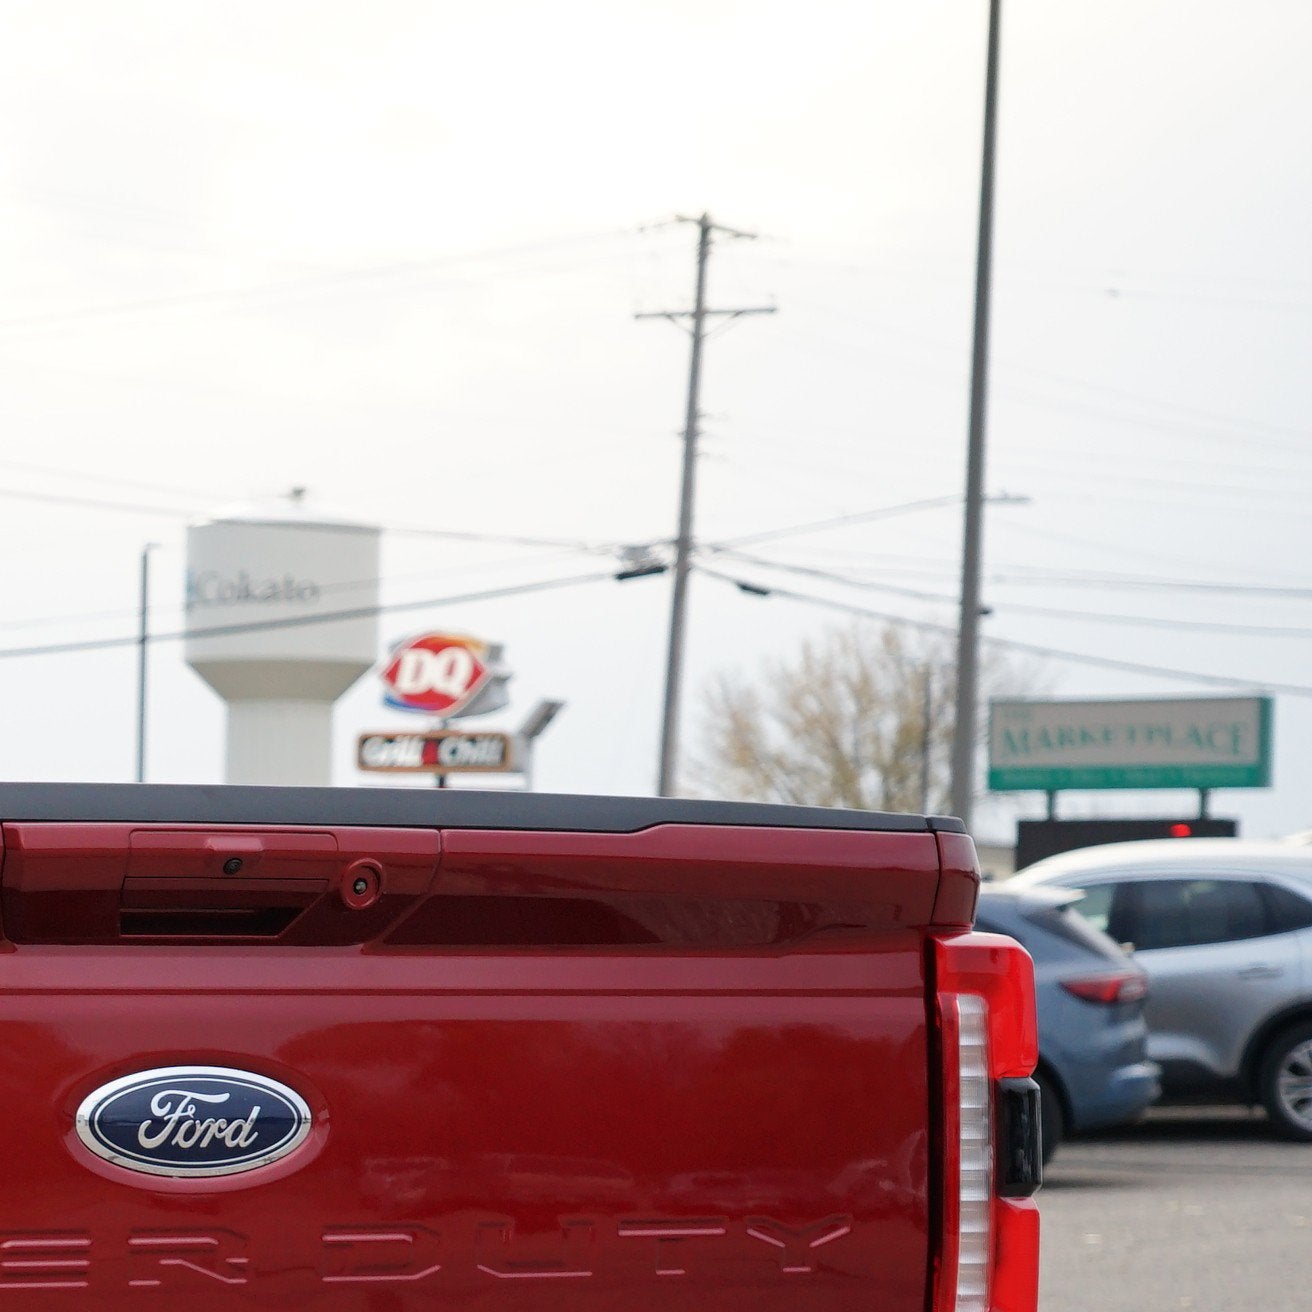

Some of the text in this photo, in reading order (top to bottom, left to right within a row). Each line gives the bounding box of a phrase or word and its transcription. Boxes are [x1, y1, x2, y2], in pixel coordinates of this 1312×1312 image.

[195, 569, 320, 605] Cokato
[395, 647, 473, 698] DQ
[137, 1089, 261, 1149] Ford
[320, 1214, 852, 1284] DUTY
